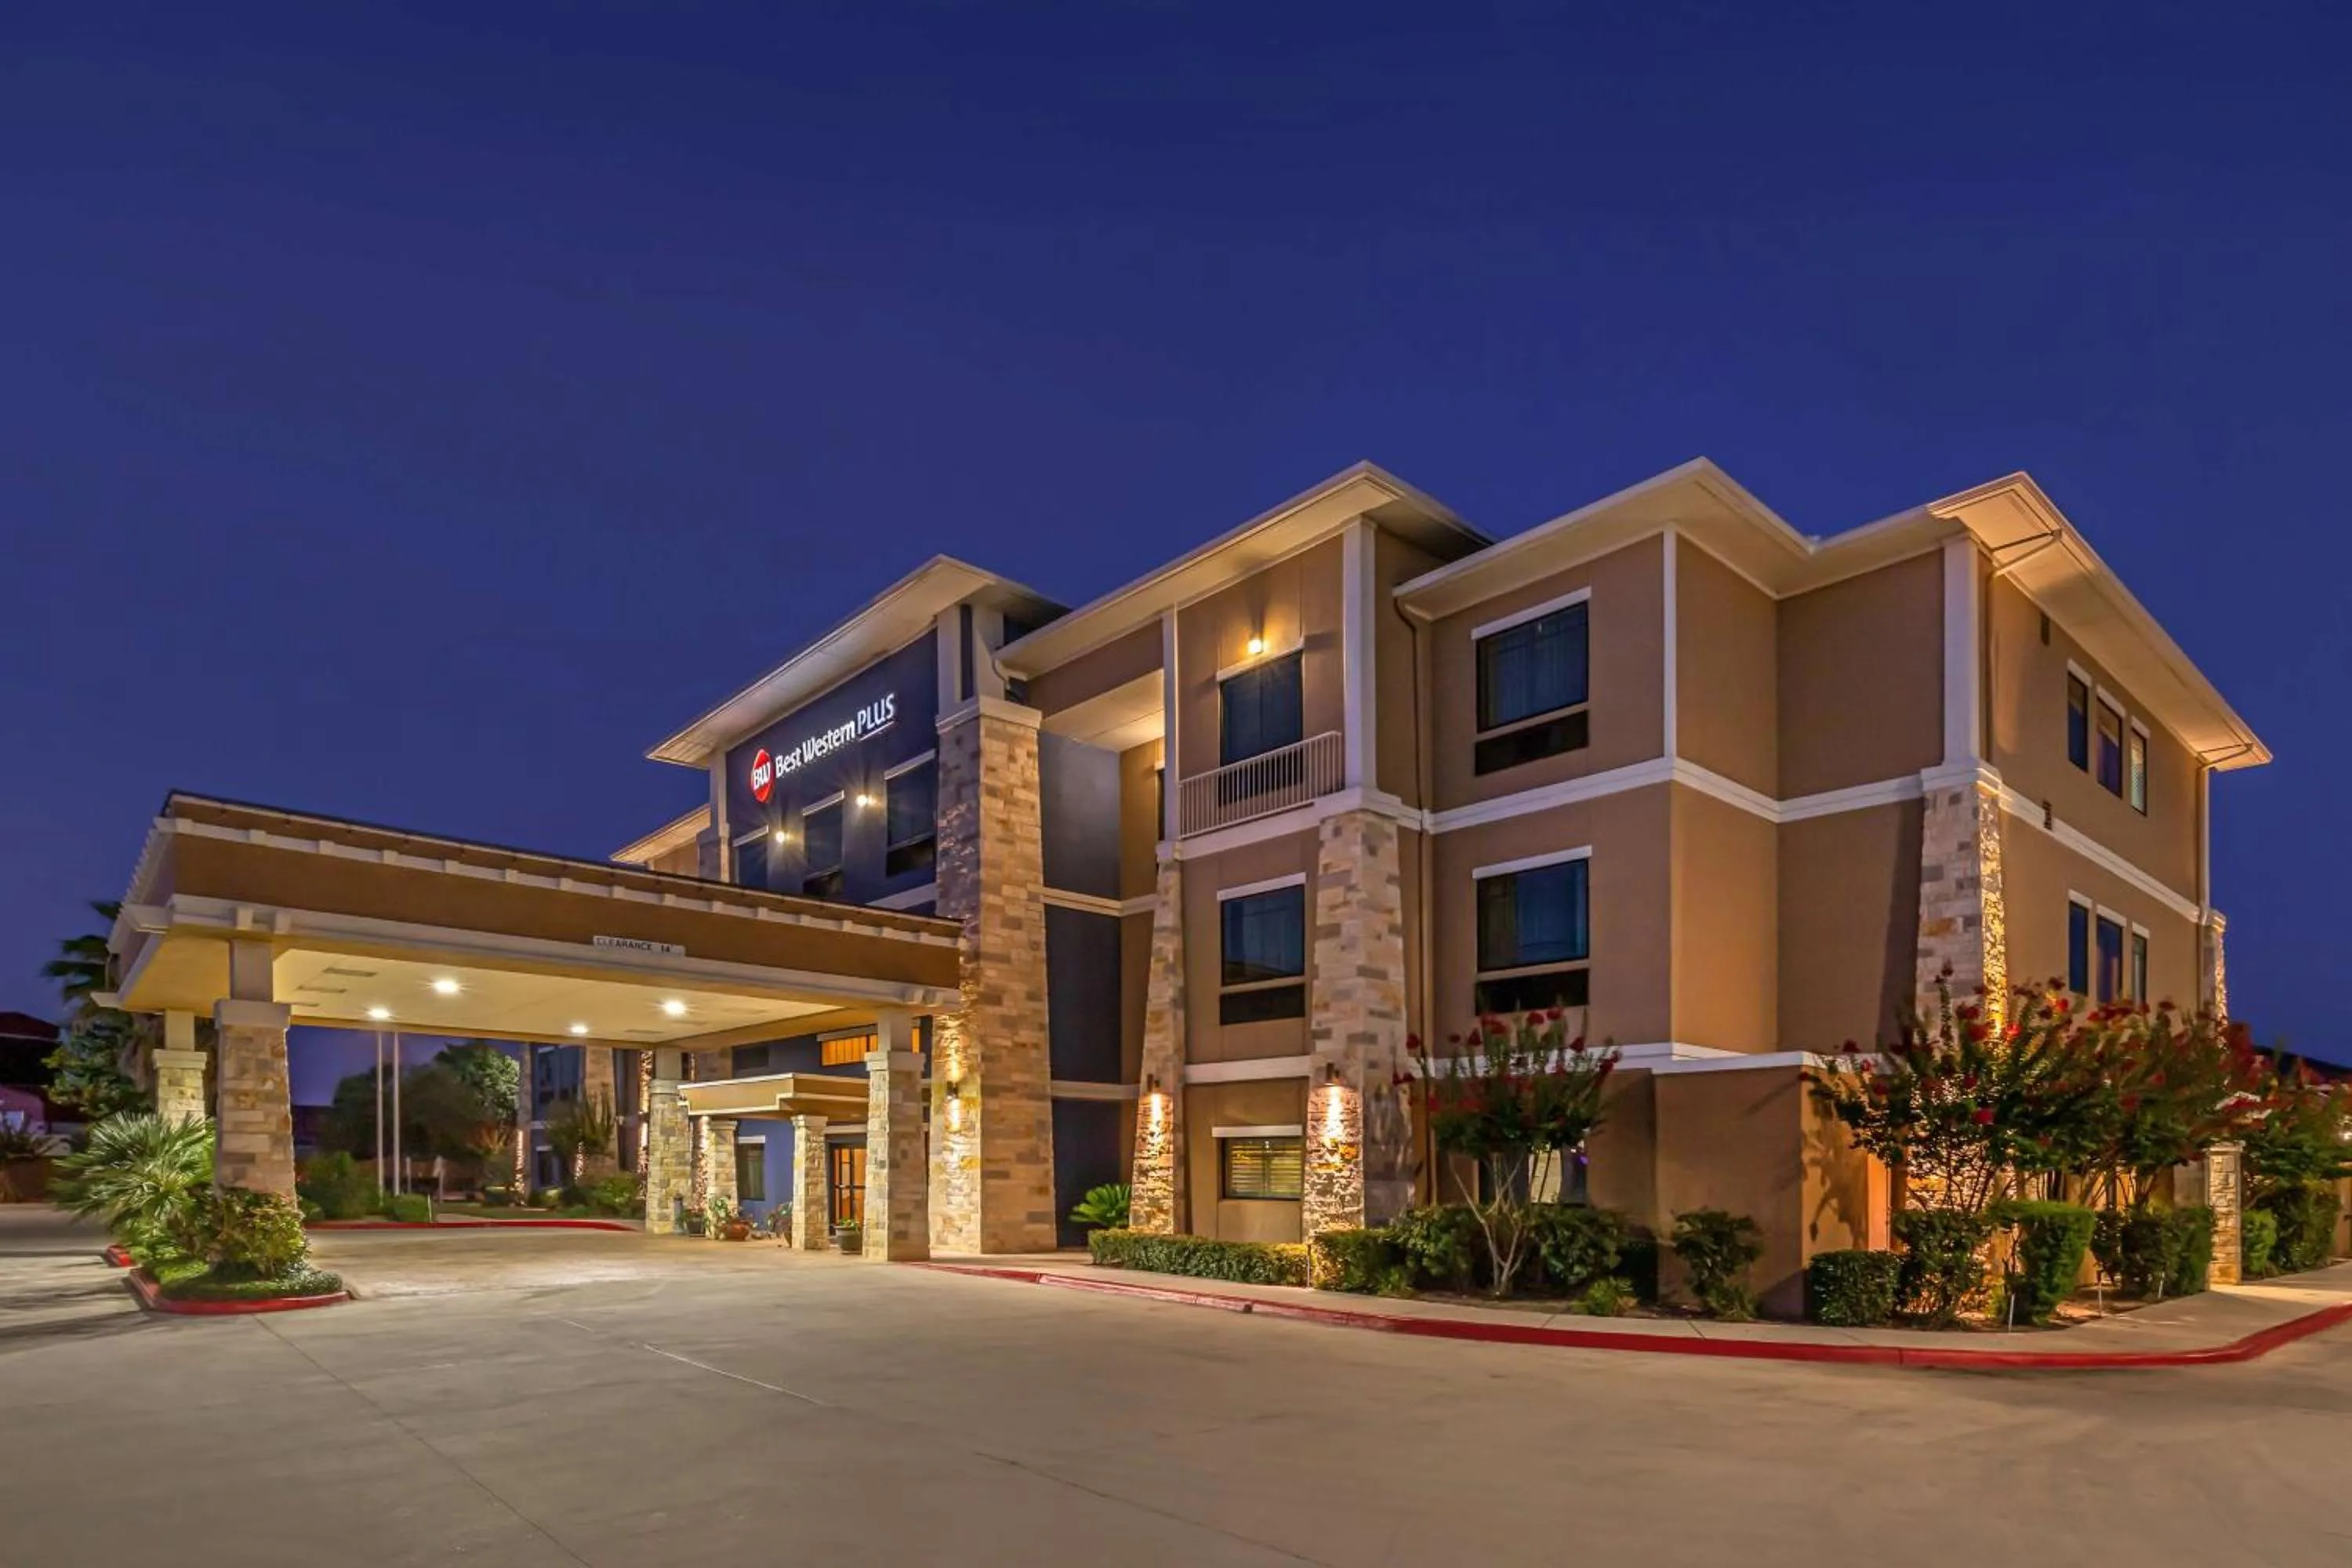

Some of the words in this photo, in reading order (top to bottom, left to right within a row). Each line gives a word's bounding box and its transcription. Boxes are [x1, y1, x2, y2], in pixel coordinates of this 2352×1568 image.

[775, 746, 801, 779] Best
[802, 720, 856, 764] Western
[856, 692, 895, 735] PLUS
[753, 761, 771, 791] BW
[595, 937, 652, 951] CLEARANCE
